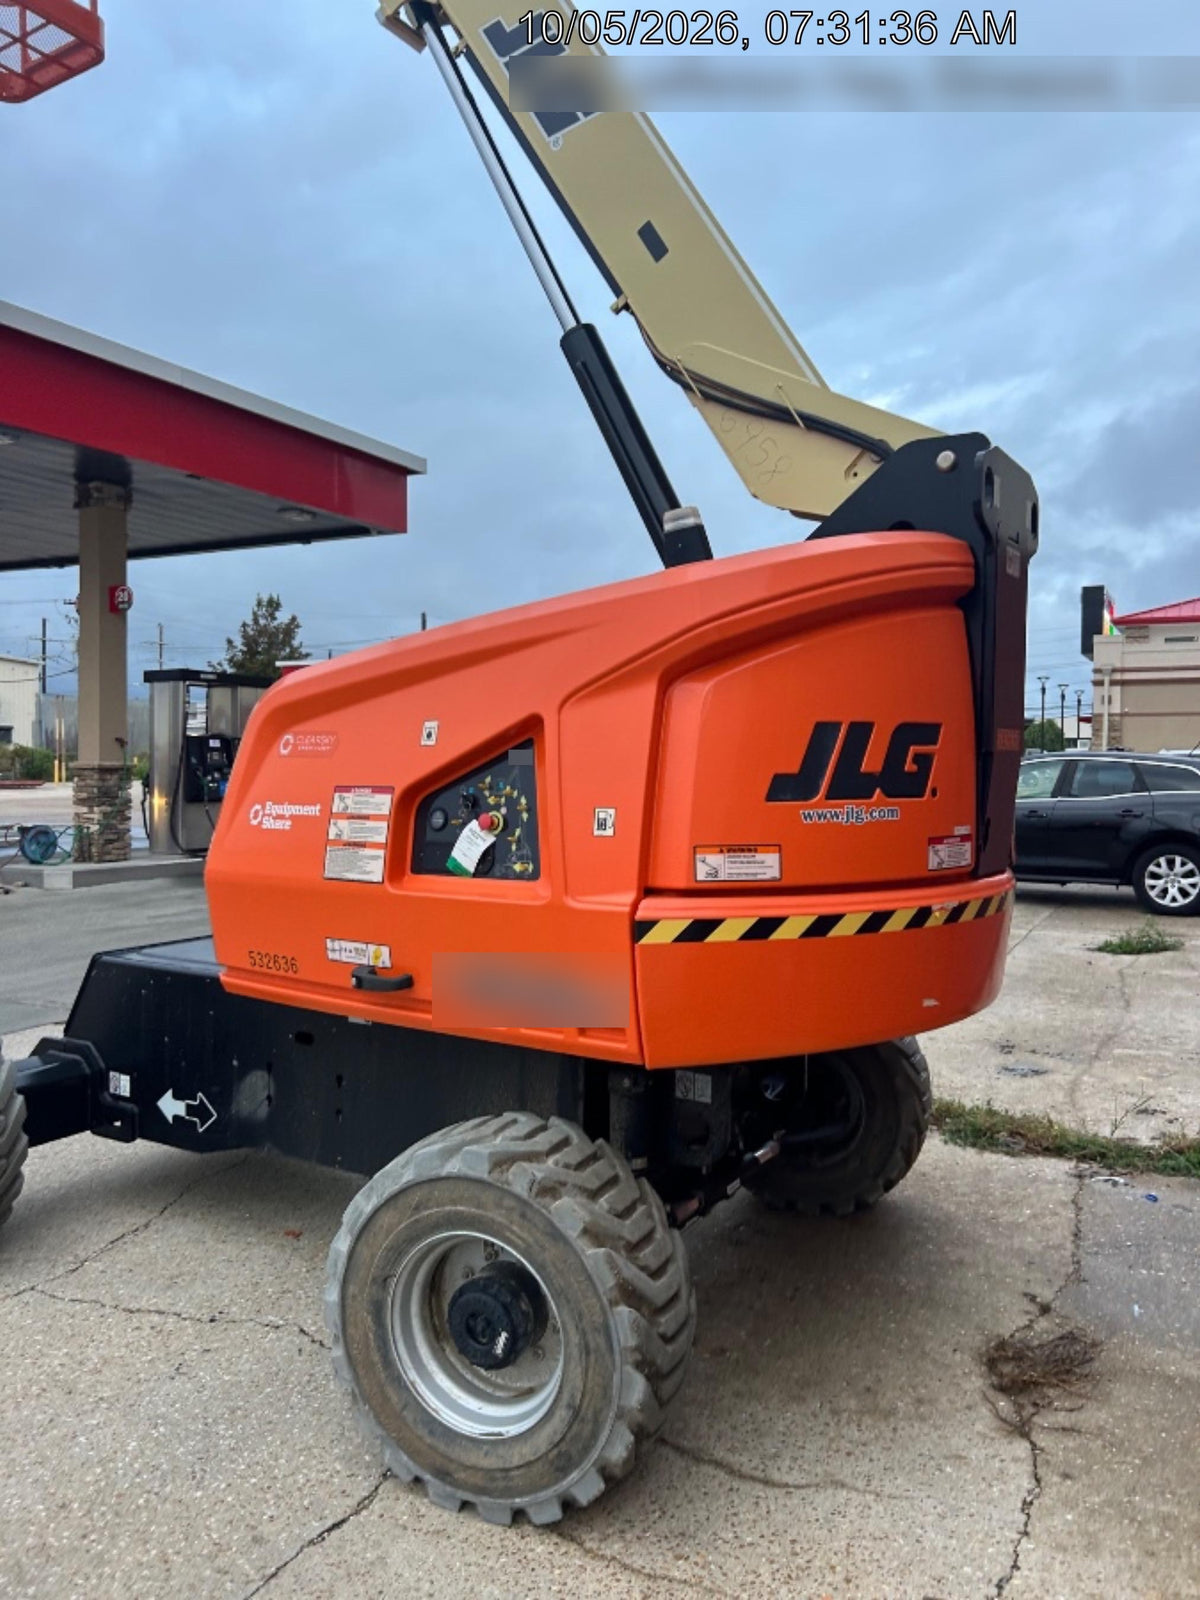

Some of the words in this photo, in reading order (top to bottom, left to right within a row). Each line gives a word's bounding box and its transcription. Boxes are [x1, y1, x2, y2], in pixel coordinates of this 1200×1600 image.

[766, 721, 943, 802] JLG
[265, 801, 321, 817] Equipment
[801, 805, 900, 823] www.jlg.com
[261, 816, 292, 830] Share
[248, 950, 299, 975] 532636
